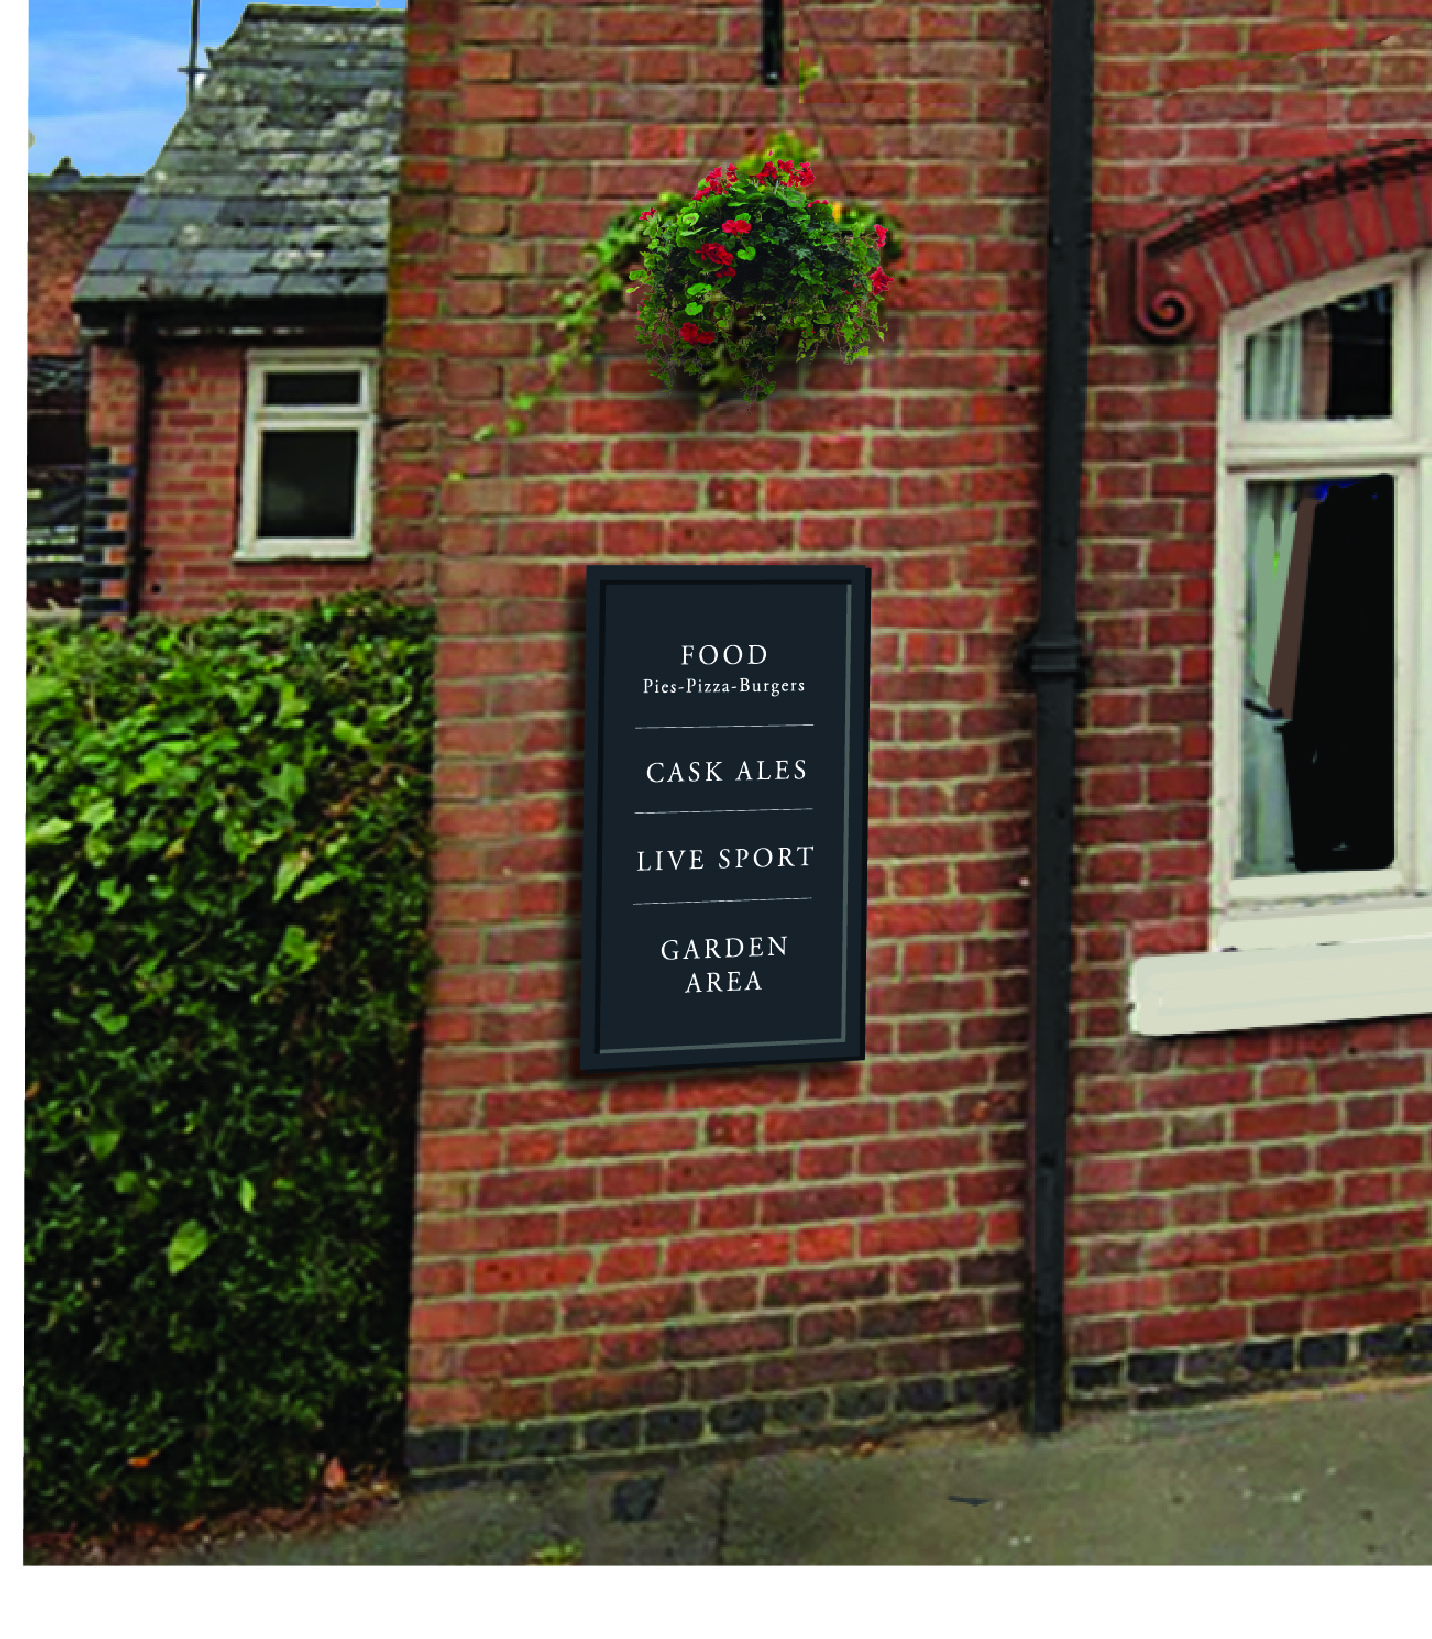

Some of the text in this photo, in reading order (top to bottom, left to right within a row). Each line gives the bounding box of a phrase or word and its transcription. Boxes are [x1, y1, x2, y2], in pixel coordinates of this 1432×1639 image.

[680, 644, 767, 666] FOOD
[646, 759, 806, 784] CASK ALES
[636, 845, 814, 872] LIVE SPORT
[661, 935, 788, 961] GARDEN
[684, 970, 763, 994] AREA
